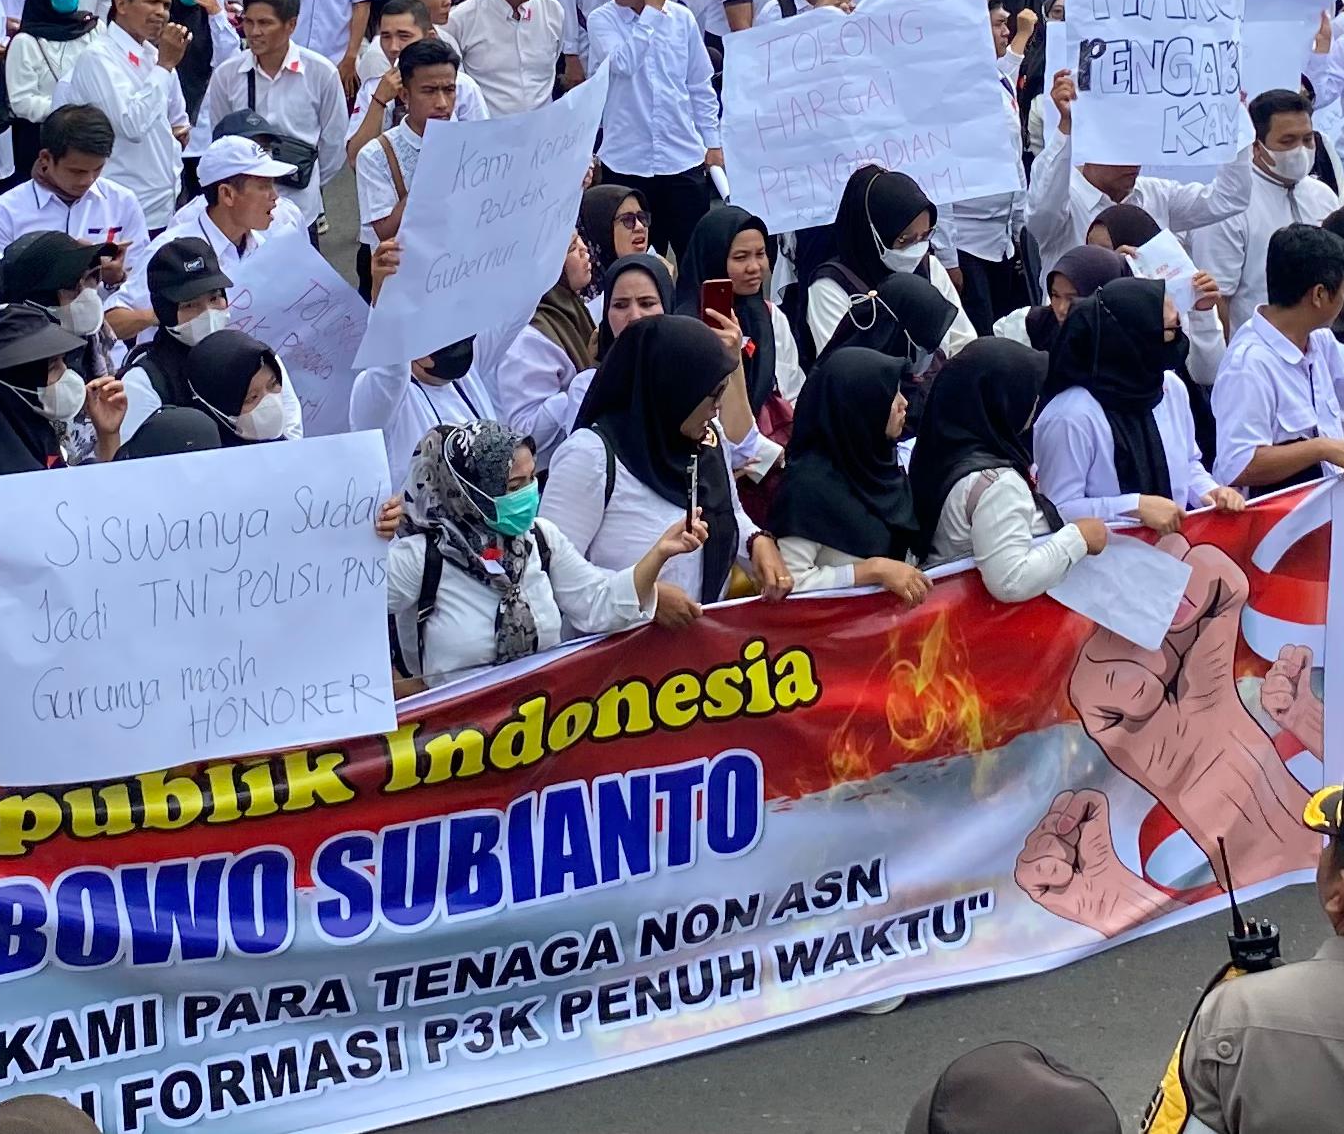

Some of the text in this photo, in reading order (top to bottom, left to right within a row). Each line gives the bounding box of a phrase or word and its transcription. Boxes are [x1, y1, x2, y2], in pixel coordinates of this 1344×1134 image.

[757, 9, 925, 83] TOLONG
[44, 500, 270, 574] Siswanya
[31, 588, 109, 645] Jadi
[342, 556, 388, 599] PNS
[31, 640, 258, 731] Gurunya masih
[189, 673, 387, 751] HONORER
[383, 641, 818, 793] Indonesia
[316, 753, 758, 941] SUBIANTO
[183, 976, 353, 1038] PARA
[373, 928, 620, 1007] TENAGA
[639, 895, 761, 957] NON
[772, 859, 885, 921] ASN
[122, 1026, 404, 1132] FORMASI
[425, 1001, 542, 1064] P3K
[560, 949, 755, 1036] PENUH
